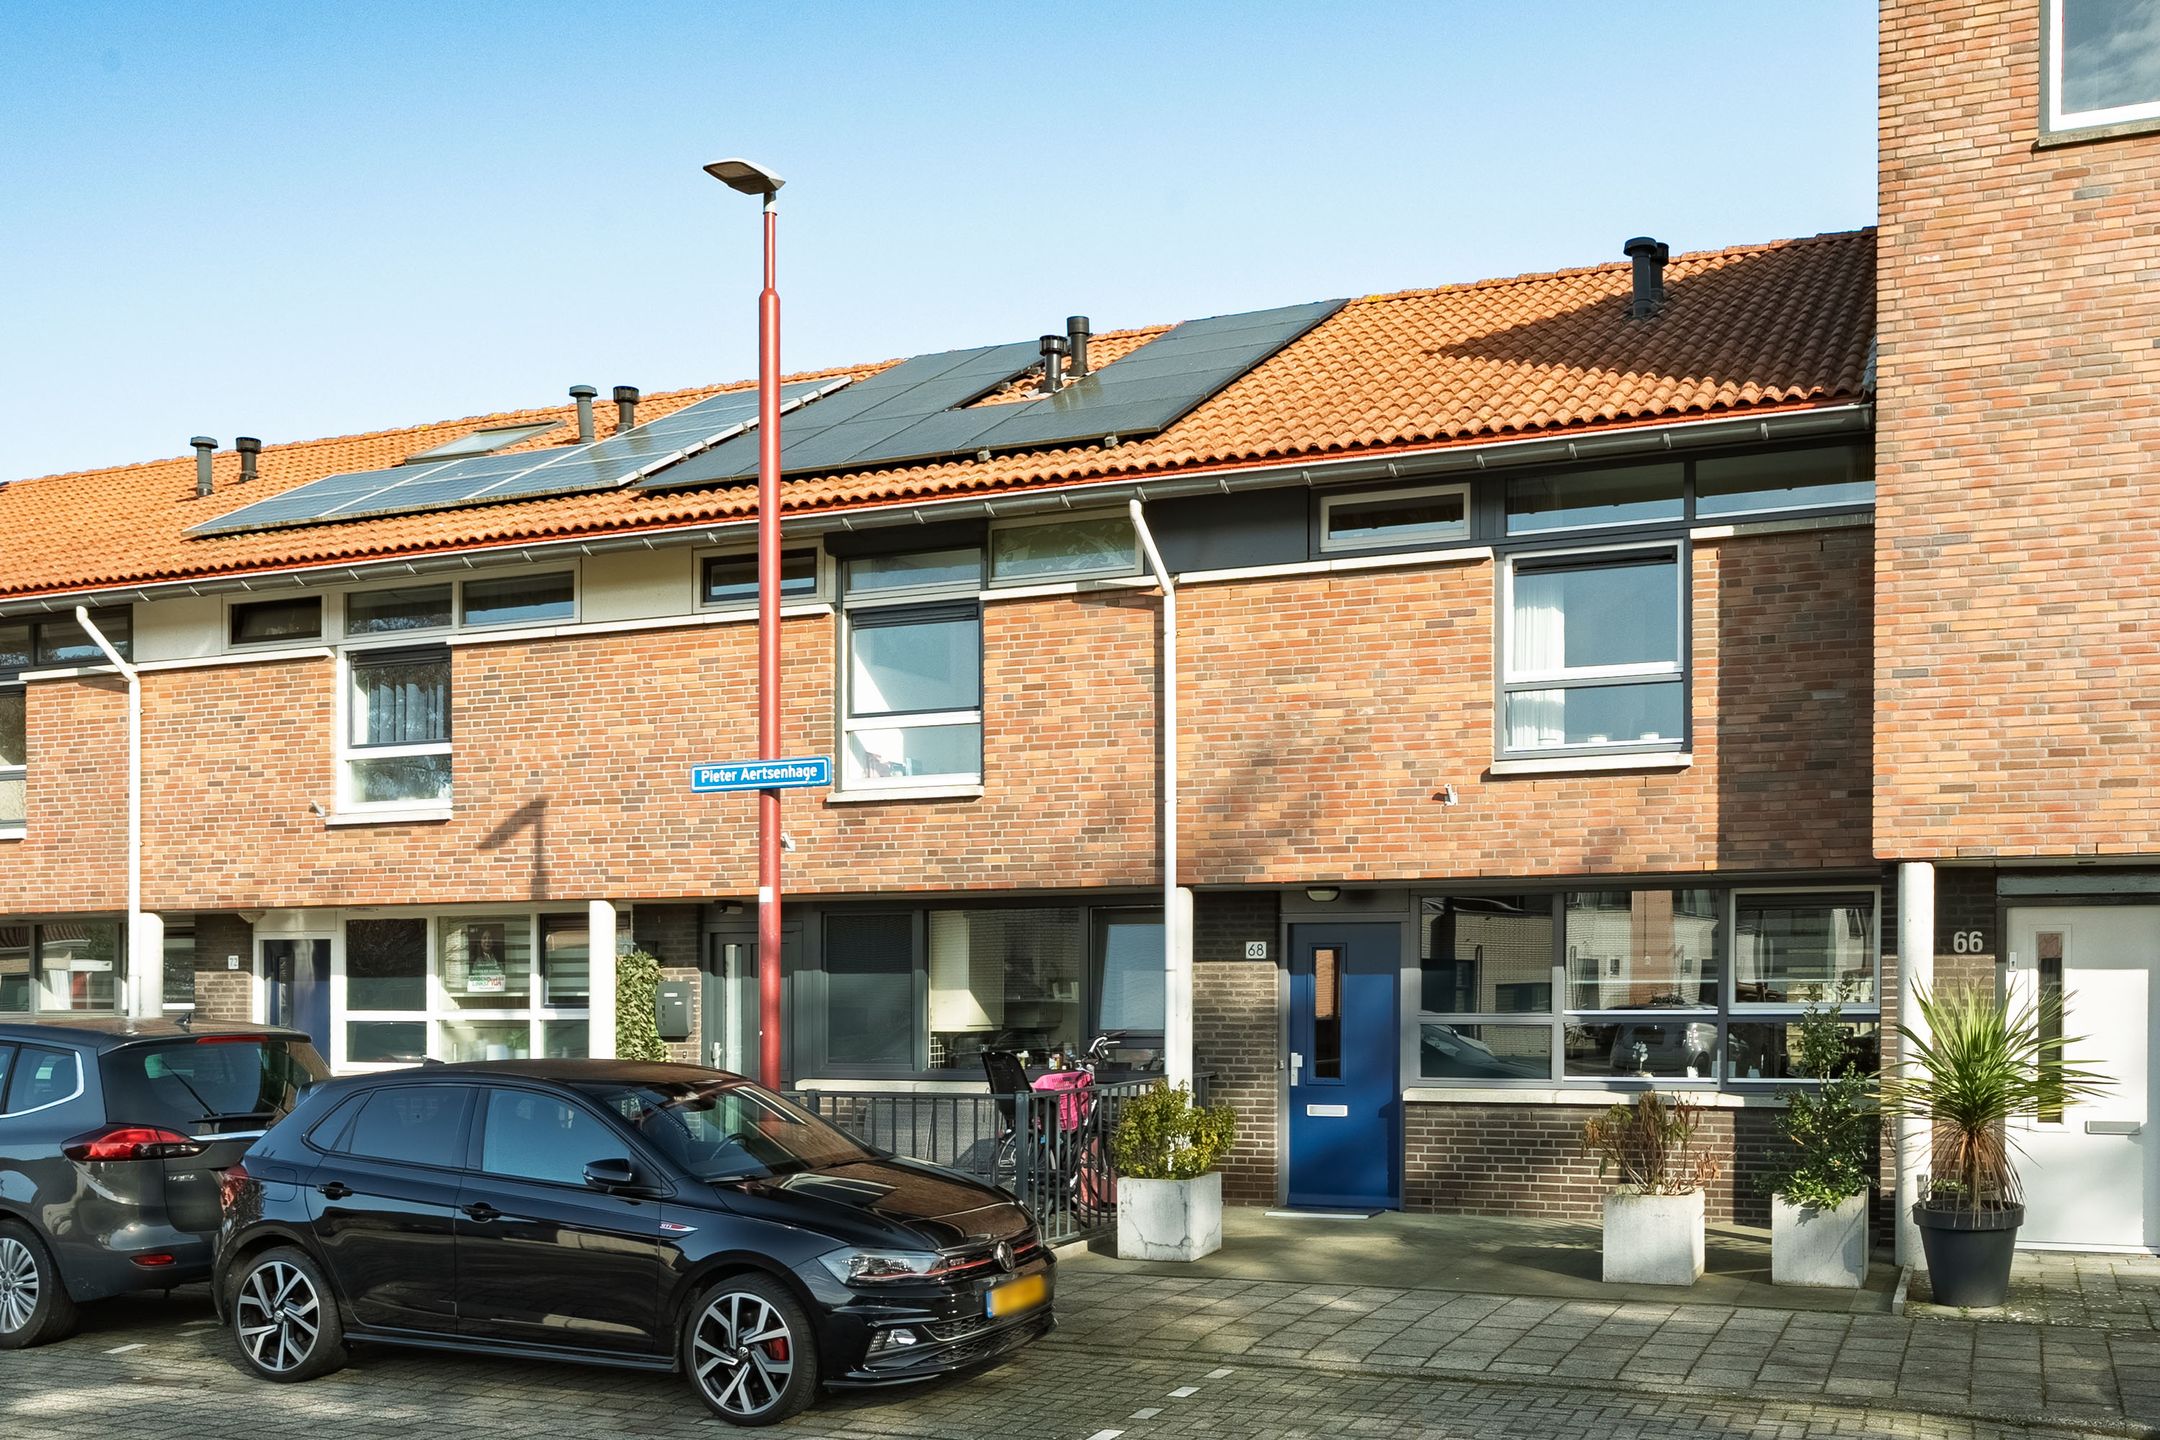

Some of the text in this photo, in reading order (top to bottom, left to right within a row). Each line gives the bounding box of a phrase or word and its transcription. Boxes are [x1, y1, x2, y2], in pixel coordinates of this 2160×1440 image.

[701, 765, 818, 783] Pieter Aertsenhage
[1247, 943, 1265, 957] 68
[1953, 930, 1984, 954] 66
